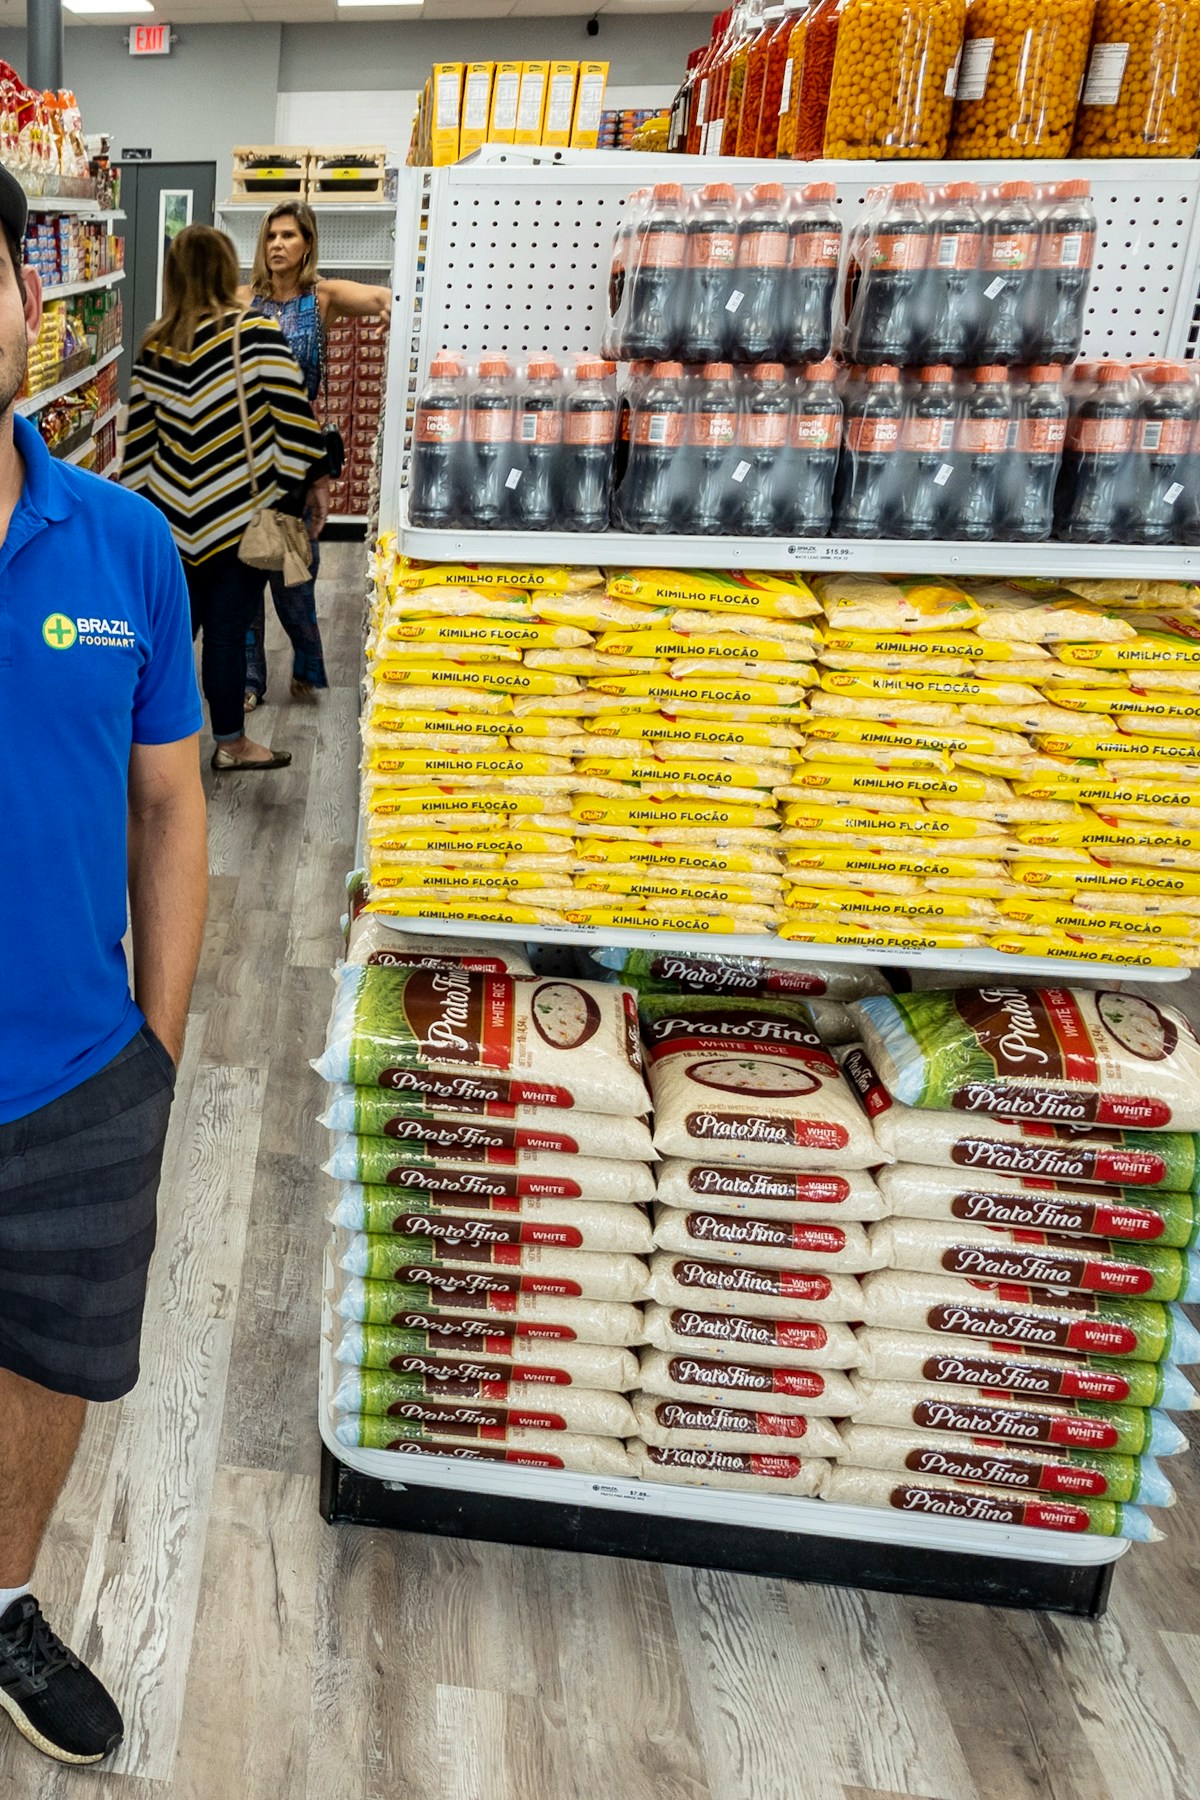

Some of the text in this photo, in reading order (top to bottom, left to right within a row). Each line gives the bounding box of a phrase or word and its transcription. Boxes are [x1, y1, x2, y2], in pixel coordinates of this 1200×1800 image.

[136, 27, 164, 51] EXIT
[446, 574, 545, 584] KIMILHO FLOCÃO
[656, 589, 760, 605] KIMILHO FLOCÃO
[77, 618, 134, 635] BRAZIL
[439, 629, 538, 639] KIMILHO FLOCÃO
[80, 636, 135, 648] FOODMART
[655, 644, 758, 658] KIMILHO FLOCÃO
[875, 642, 984, 656] KIMILHO FLOCÃO
[432, 672, 530, 686] KIMILHO FLOCÃO
[874, 679, 980, 694] KIMILHO FLOCÃO
[425, 760, 524, 771] KIMILHO FLOCÃO
[852, 778, 958, 792] KIMILHO FLOCÃO
[629, 810, 728, 822] KIMILHO FLOCÃO
[1082, 835, 1191, 848] KIMILHO FLOCÃO
[846, 860, 949, 874] KIMILHO FLOCÃO
[613, 915, 710, 930] KIMILHO FLOCÃO
[1055, 916, 1162, 934] KIMILHO FLOCÃO
[779, 979, 812, 990] WHITE
[492, 983, 505, 1028] WHITE RICE
[699, 1041, 788, 1054] WHITE RICE
[522, 1090, 557, 1103] WHITE
[1112, 1104, 1152, 1117] WHITE
[807, 1128, 836, 1137] WHITE
[527, 1138, 562, 1150] WHITE
[533, 1232, 566, 1242] WHITE
[1100, 1271, 1139, 1284] WHITE
[787, 1328, 816, 1338] WHITE
[1084, 1331, 1122, 1344] WHITE
[523, 1373, 556, 1382] WHITE
[784, 1376, 813, 1386] WHITE
[519, 1418, 551, 1427] WHITE
[1067, 1426, 1104, 1440] WHITE
[1040, 1511, 1076, 1524] WHITE
